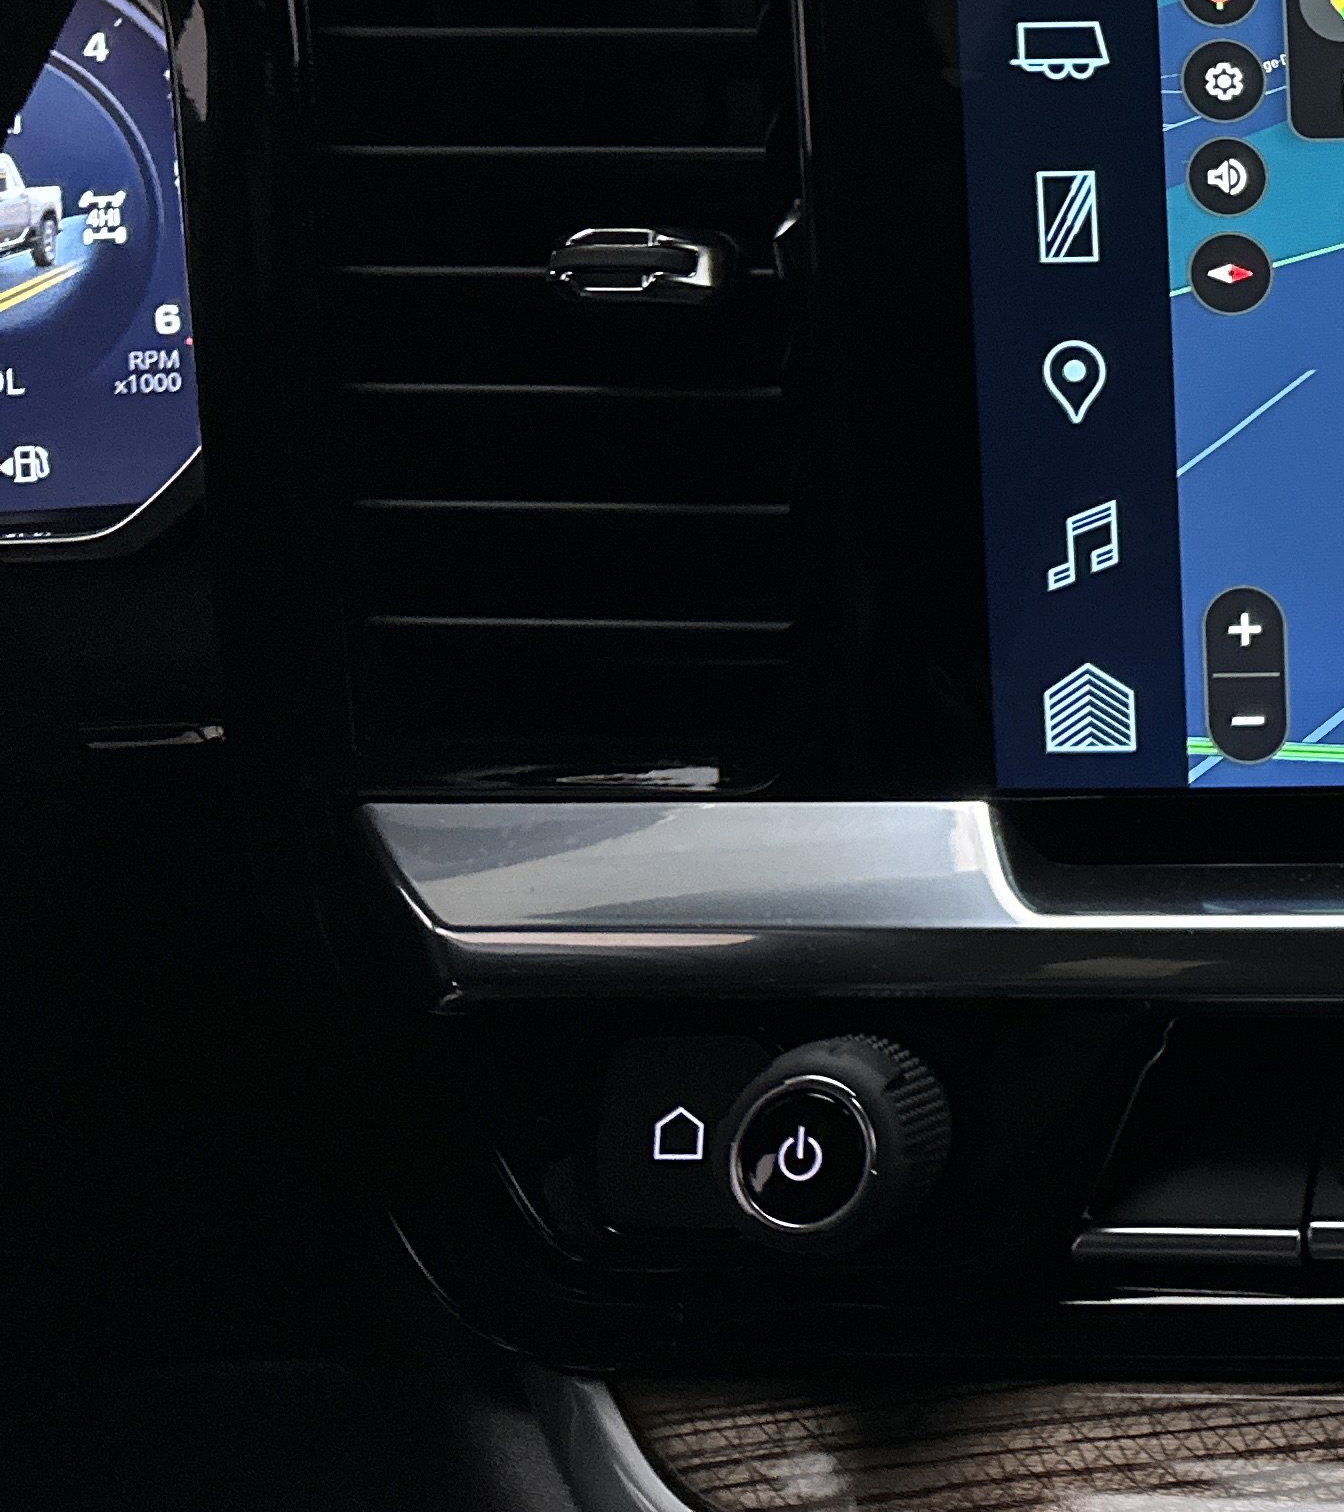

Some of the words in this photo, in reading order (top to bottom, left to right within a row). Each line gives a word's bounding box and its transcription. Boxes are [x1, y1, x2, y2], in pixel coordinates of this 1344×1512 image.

[82, 32, 110, 62] 4
[154, 304, 181, 335] 6
[127, 350, 180, 372] RPM
[113, 373, 183, 397] x1000
